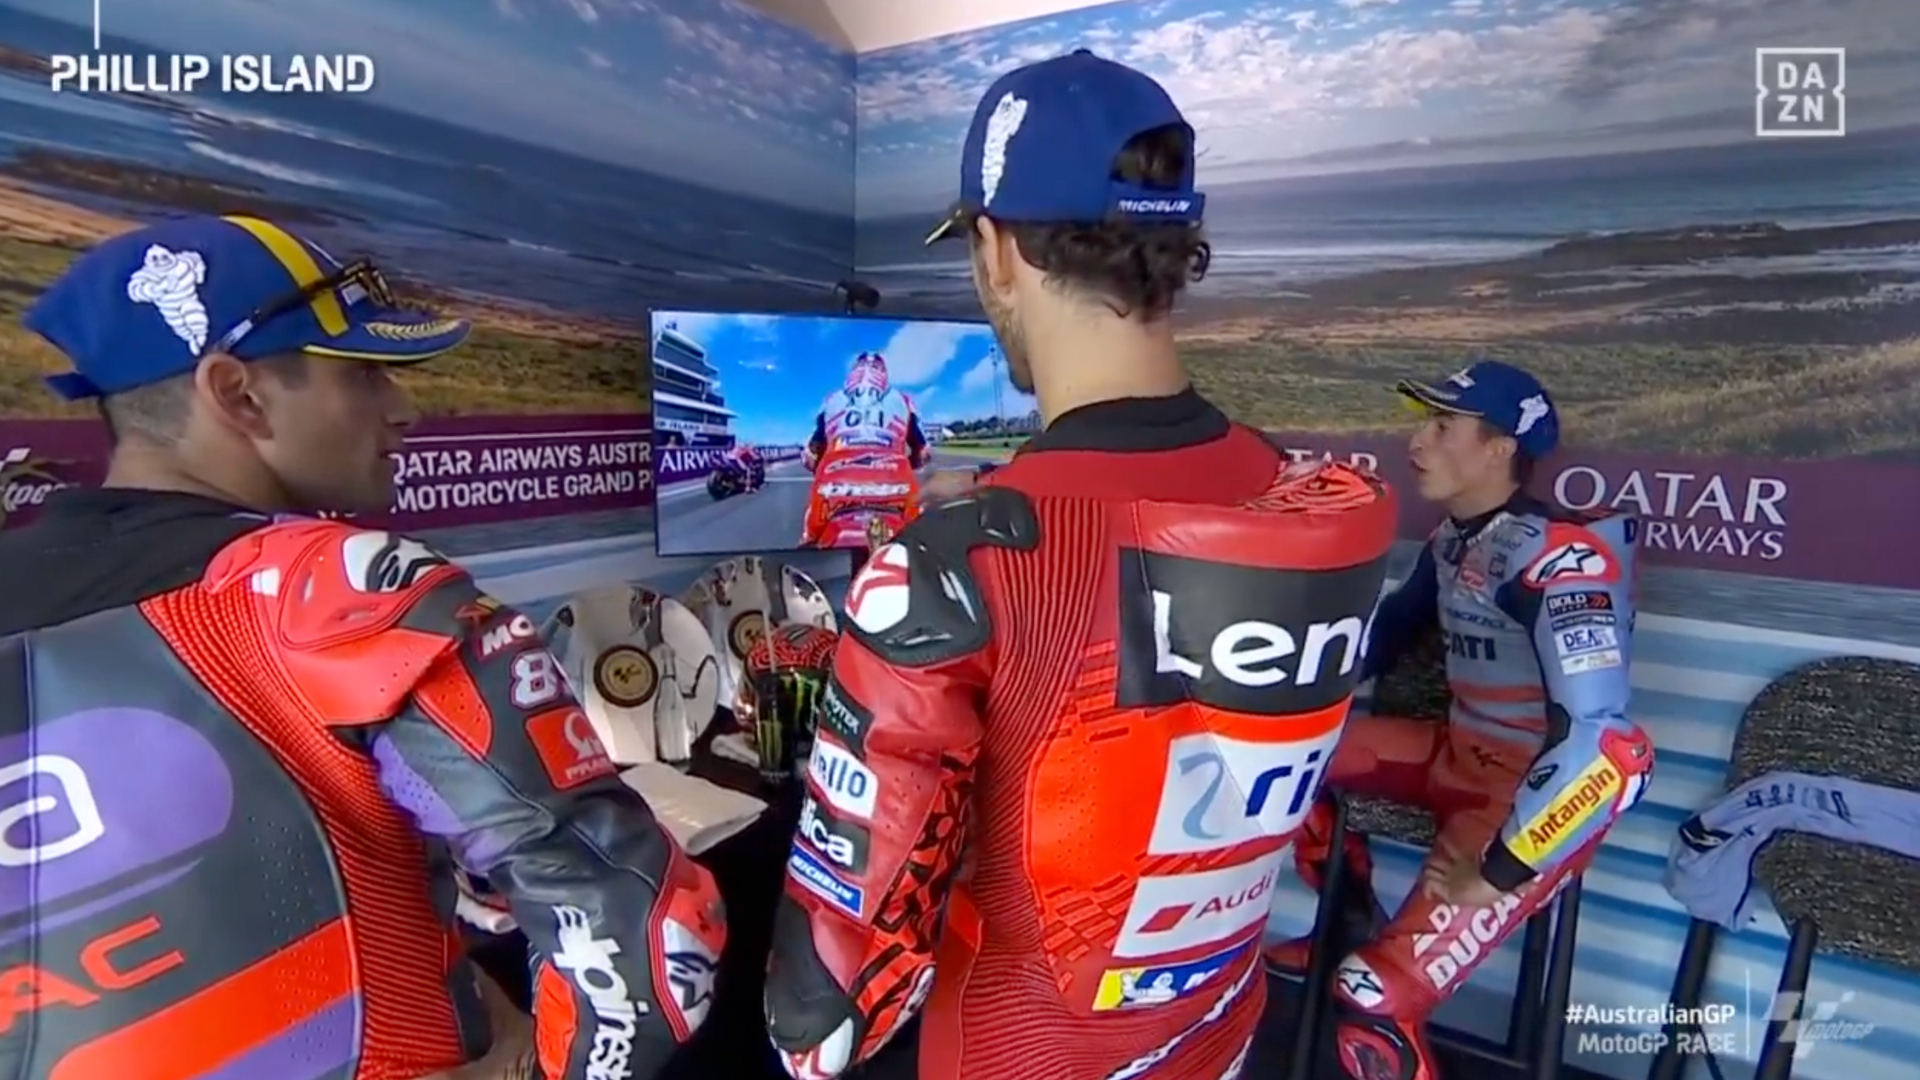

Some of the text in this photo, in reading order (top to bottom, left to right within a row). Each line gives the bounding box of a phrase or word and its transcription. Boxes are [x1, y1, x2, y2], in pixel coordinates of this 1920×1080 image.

[478, 445, 583, 474] AIRWAYS
[390, 475, 560, 514] MOTORCYCLE
[563, 470, 635, 497] GRAND
[1553, 465, 1788, 526] QATAR
[1638, 519, 1785, 561] RWAYS
[1152, 588, 1381, 687] Len
[510, 650, 562, 706] 8
[814, 754, 868, 799] ello
[1526, 766, 1617, 854] Antangin
[1194, 868, 1276, 920] Audi
[1425, 884, 1528, 990] DUCA
